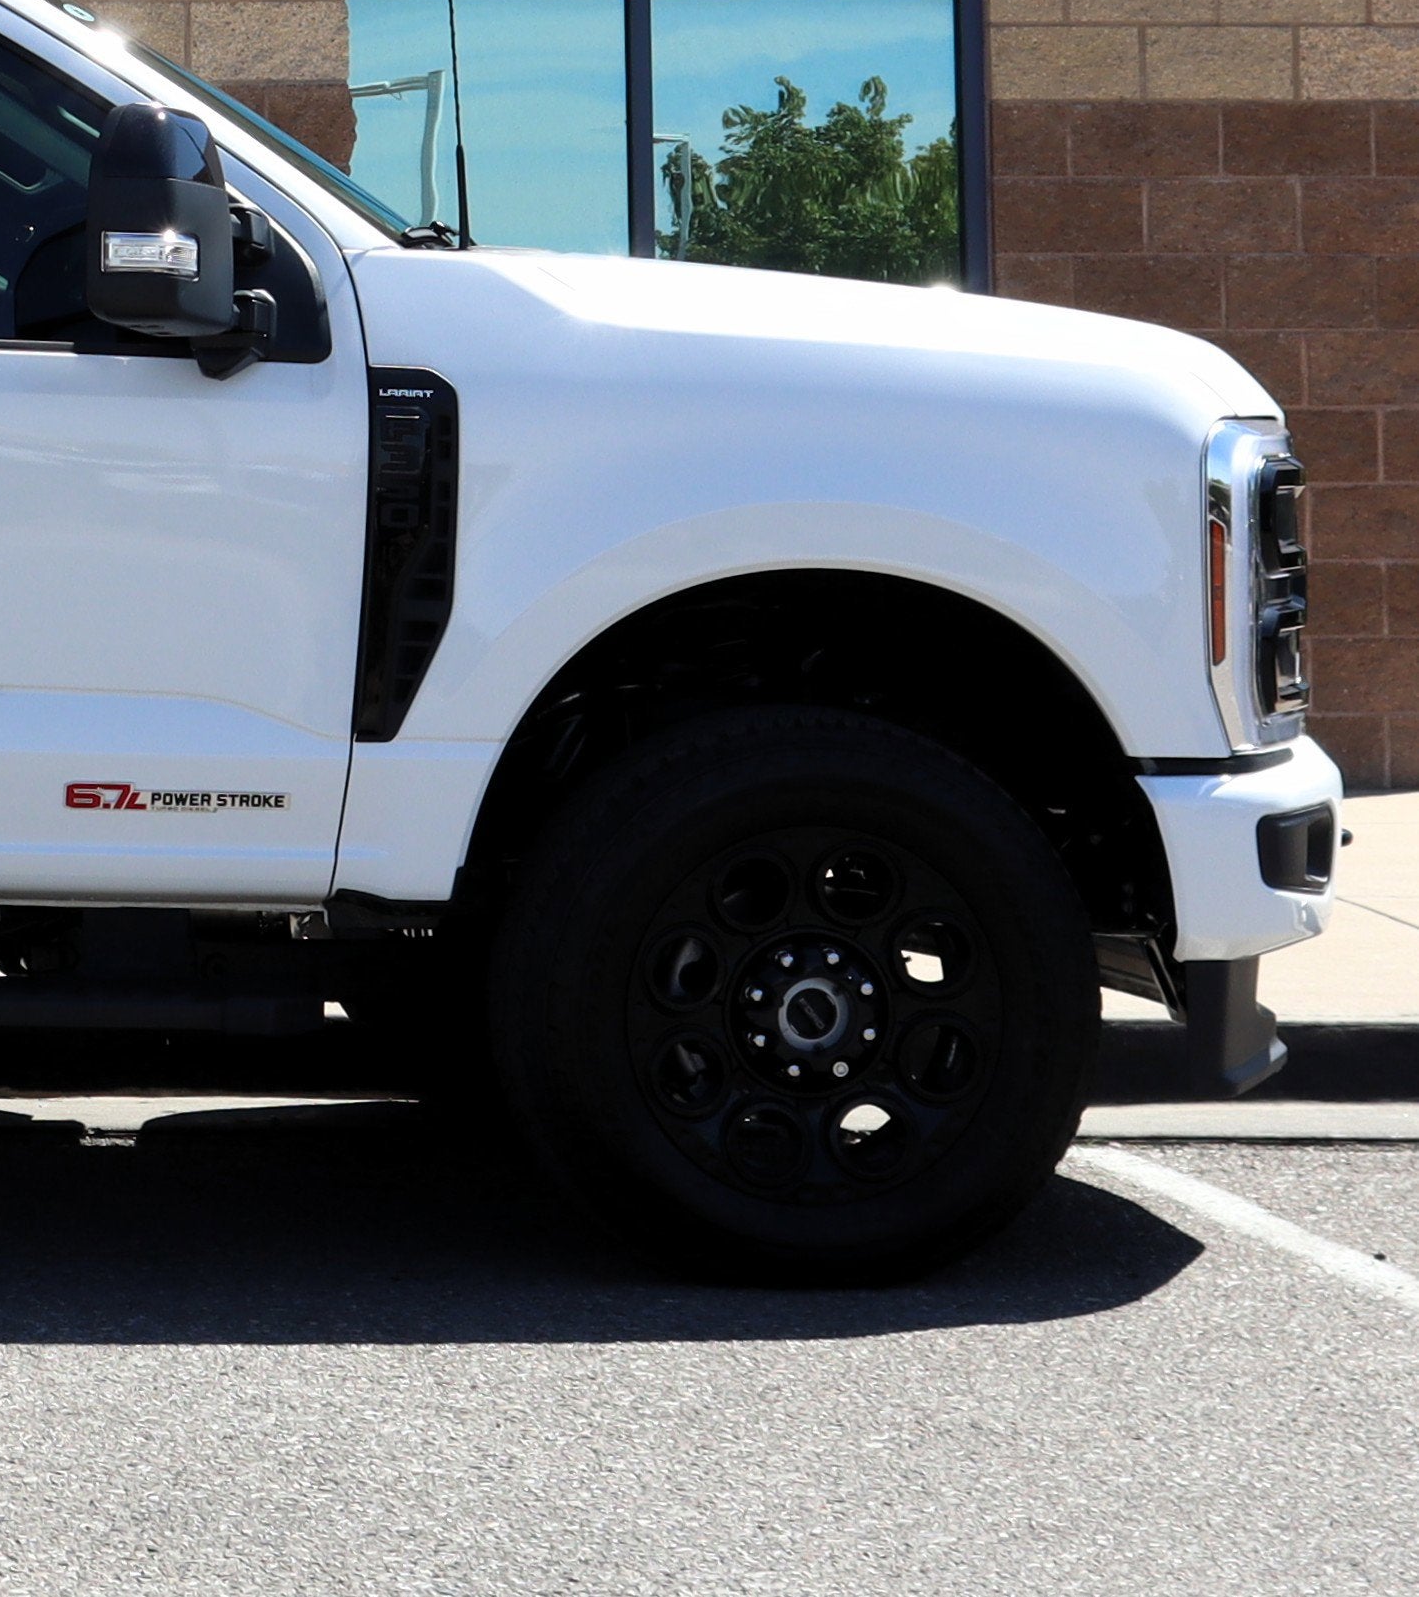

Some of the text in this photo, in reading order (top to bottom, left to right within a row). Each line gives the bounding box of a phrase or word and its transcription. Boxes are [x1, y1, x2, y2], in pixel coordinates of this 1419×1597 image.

[379, 388, 434, 398] LARIAT
[151, 792, 211, 806] POWER
[217, 793, 285, 808] STROKE
